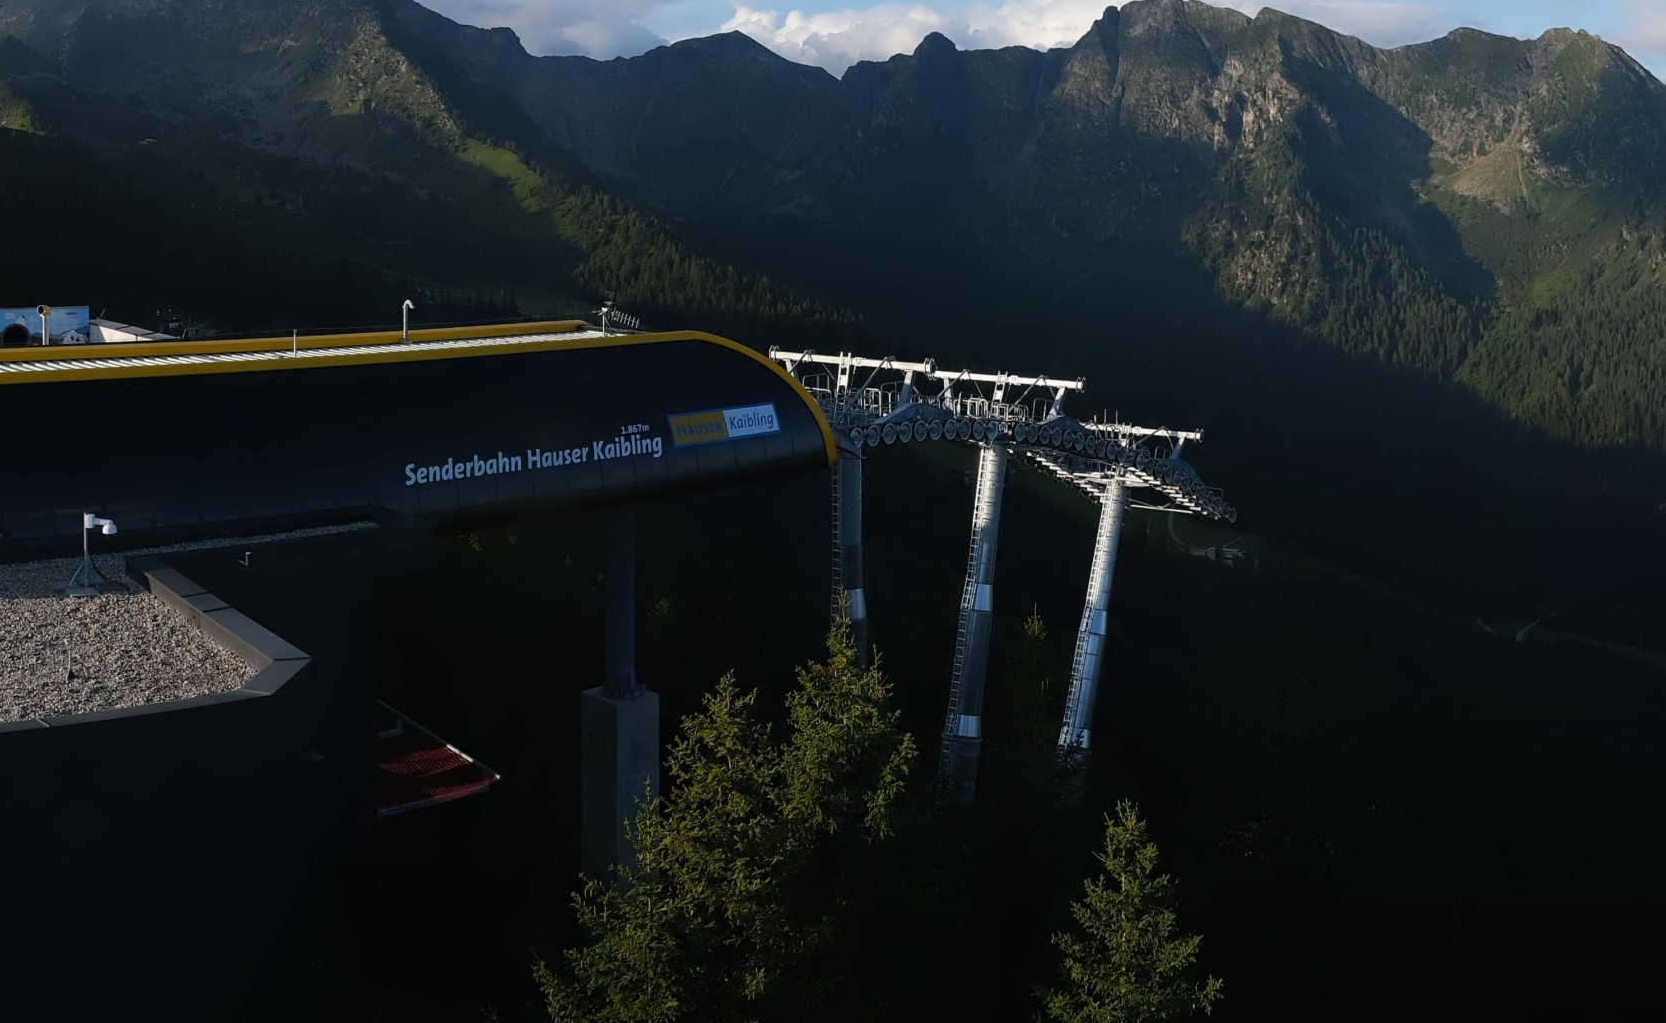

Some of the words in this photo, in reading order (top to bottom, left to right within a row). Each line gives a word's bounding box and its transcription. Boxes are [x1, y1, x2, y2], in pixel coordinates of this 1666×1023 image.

[620, 423, 650, 435] 1.867m
[676, 421, 723, 437] HAUSER
[729, 412, 774, 430] Kaibling
[405, 451, 522, 486] Senderbahn
[527, 444, 589, 470] Hauser
[592, 434, 663, 461] Kaibling
